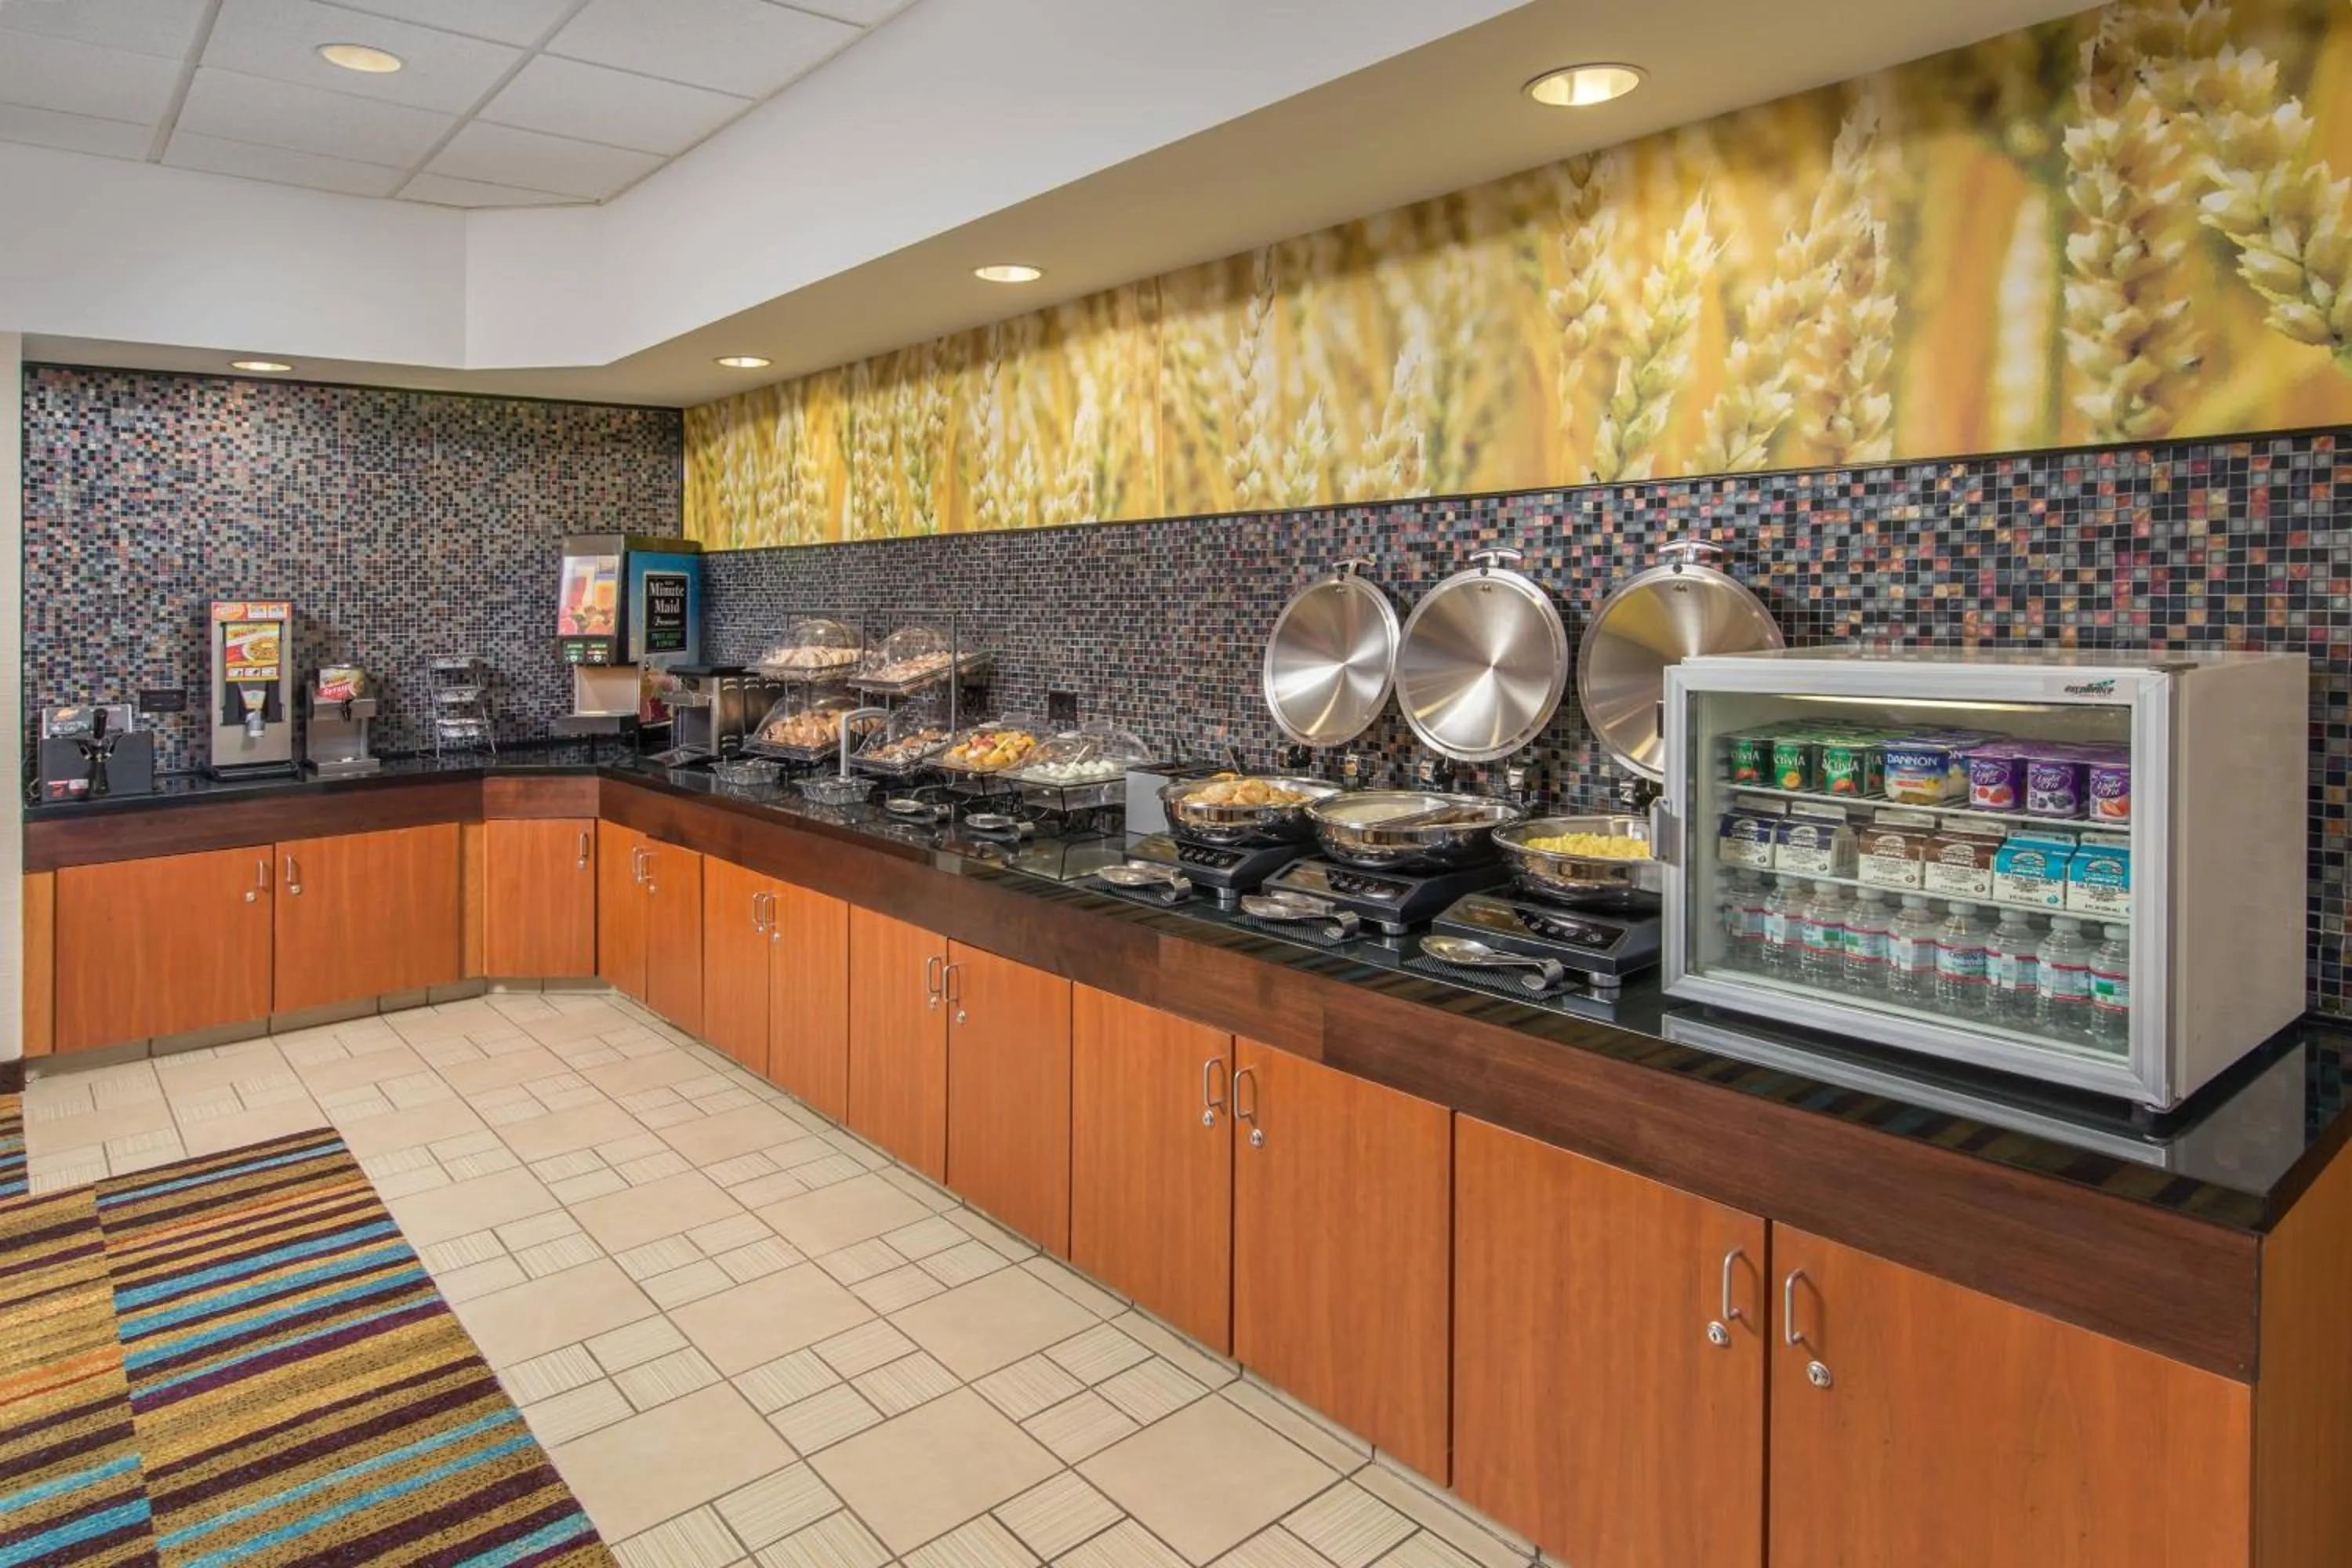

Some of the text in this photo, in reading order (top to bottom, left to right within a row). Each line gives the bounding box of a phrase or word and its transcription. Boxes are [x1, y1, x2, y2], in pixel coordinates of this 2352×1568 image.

[648, 582, 684, 597] Minute
[654, 598, 680, 613] Maid
[1887, 753, 1937, 766] DANNON
